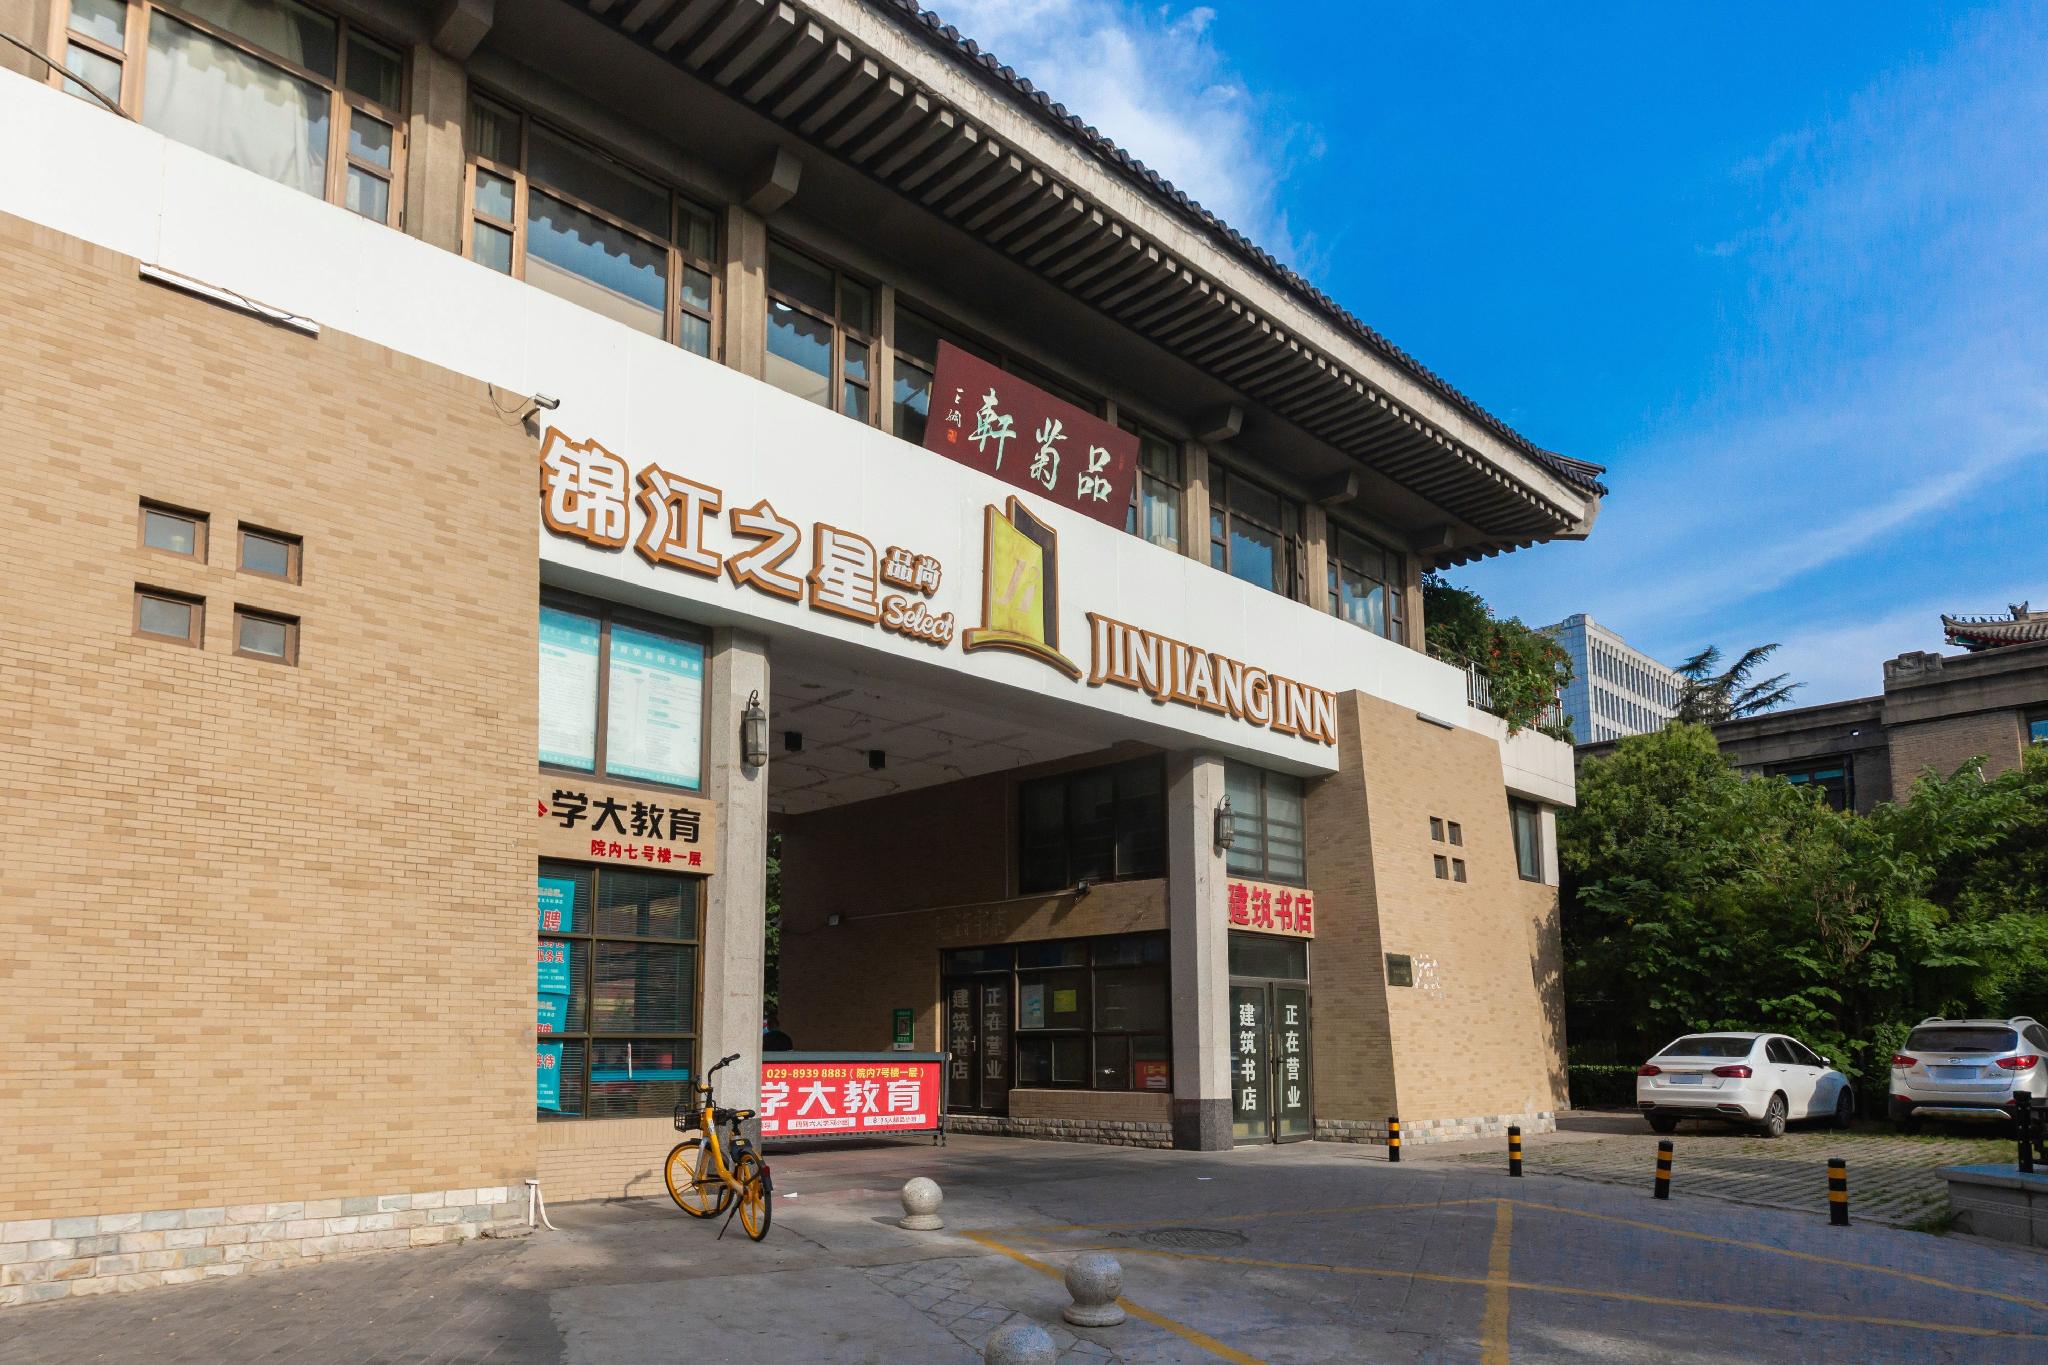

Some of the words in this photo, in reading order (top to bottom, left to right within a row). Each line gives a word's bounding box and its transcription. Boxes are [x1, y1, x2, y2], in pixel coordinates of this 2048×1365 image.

[541, 430, 879, 622] 锦江之星
[882, 549, 942, 593] 品尚
[882, 597, 954, 643] Select
[1089, 614, 1269, 725] JINJIANG
[1270, 676, 1335, 743] INN
[551, 789, 701, 843] 学大教育
[591, 839, 702, 866] 院内七号楼一层
[1228, 882, 1313, 933] 建筑书店
[952, 988, 971, 1080] 建筑书店
[984, 987, 1003, 1080] 正在营业
[1239, 1003, 1256, 1111] 建筑书店
[1285, 1004, 1301, 1108] 正在营业
[761, 1079, 921, 1117] 学大教育
[767, 1068, 819, 1079] 029-8939
[821, 1068, 847, 1078] 8883
